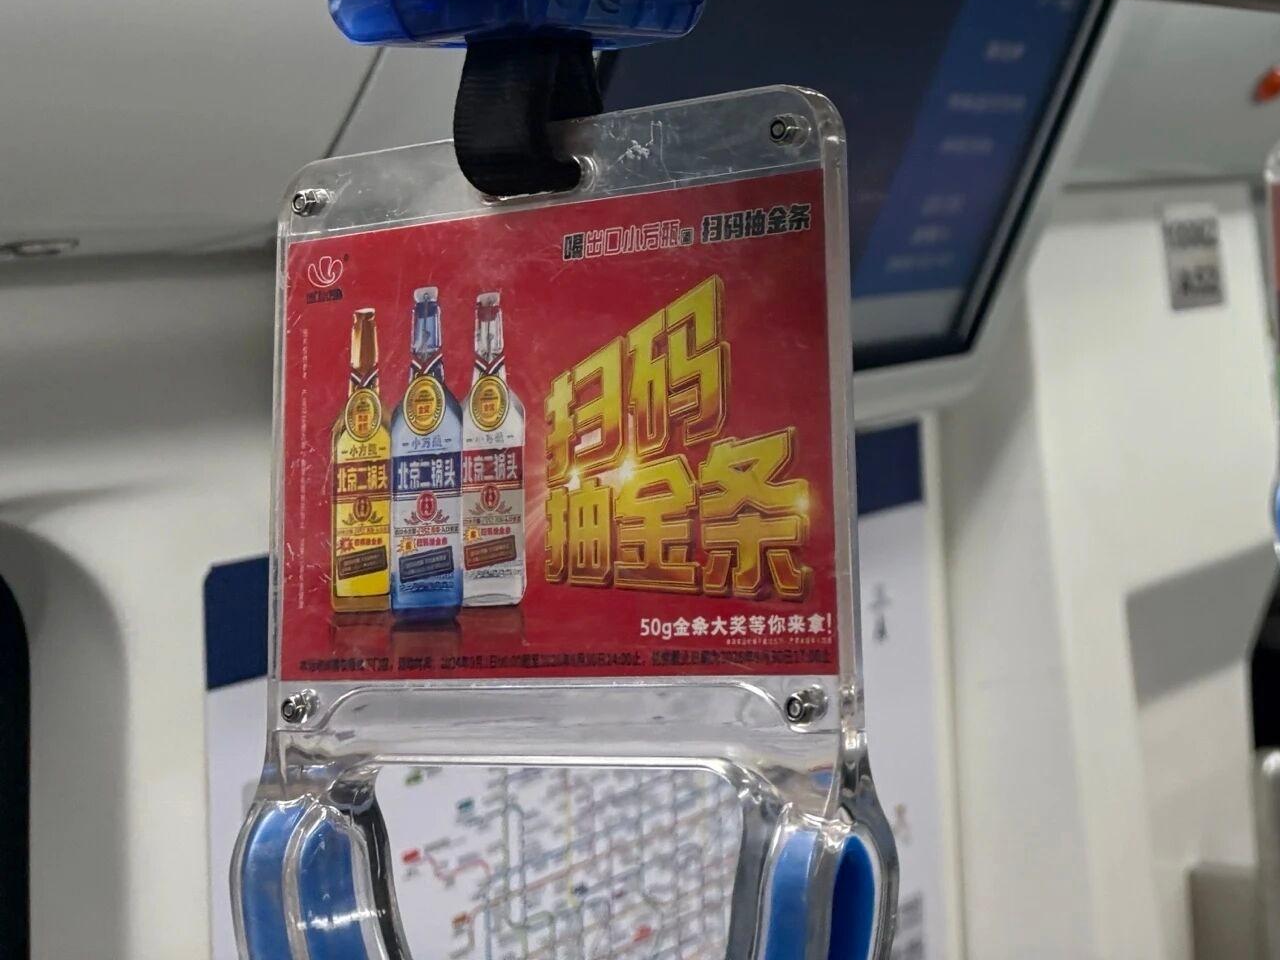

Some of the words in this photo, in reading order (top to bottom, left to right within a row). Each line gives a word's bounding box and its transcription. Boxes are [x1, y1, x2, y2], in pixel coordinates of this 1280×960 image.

[701, 203, 812, 244] 扫码抽金条
[544, 274, 731, 488] 扫码
[337, 464, 388, 492] 北京二锅头
[398, 456, 456, 489] 北京二锅头
[462, 452, 518, 483] 北京二锅头
[544, 426, 813, 603] 抽金条
[640, 612, 832, 640] 50g金条大奖等你来拿!
